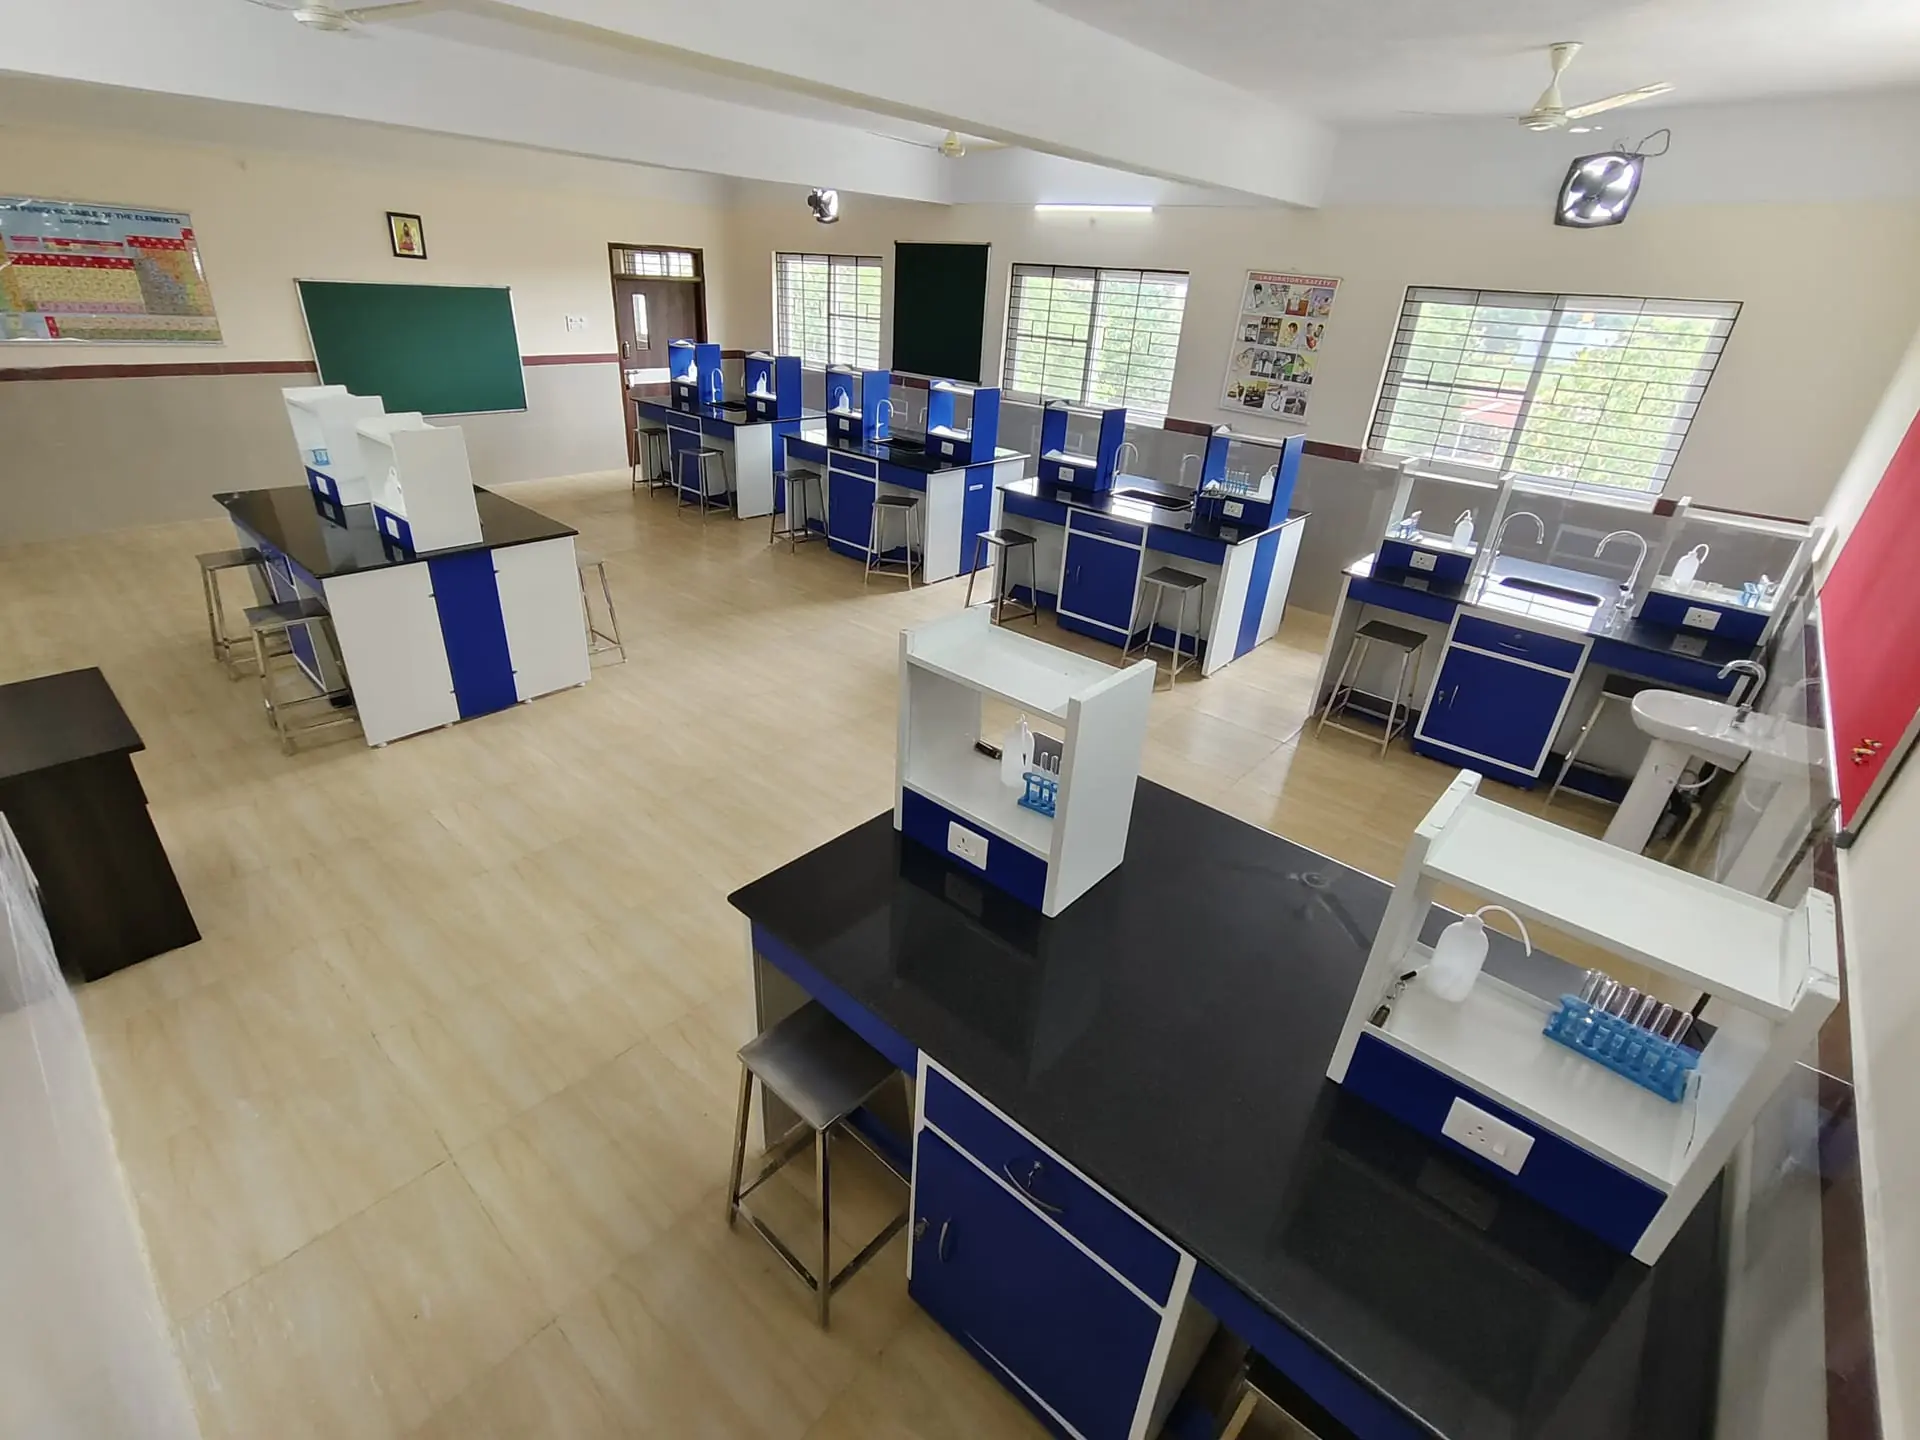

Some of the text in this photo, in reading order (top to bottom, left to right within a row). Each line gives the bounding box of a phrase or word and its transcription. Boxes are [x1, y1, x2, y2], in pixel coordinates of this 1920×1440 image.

[69, 209, 98, 218] TABLE
[115, 213, 132, 221] THE
[135, 215, 181, 224] ELEMENTS
